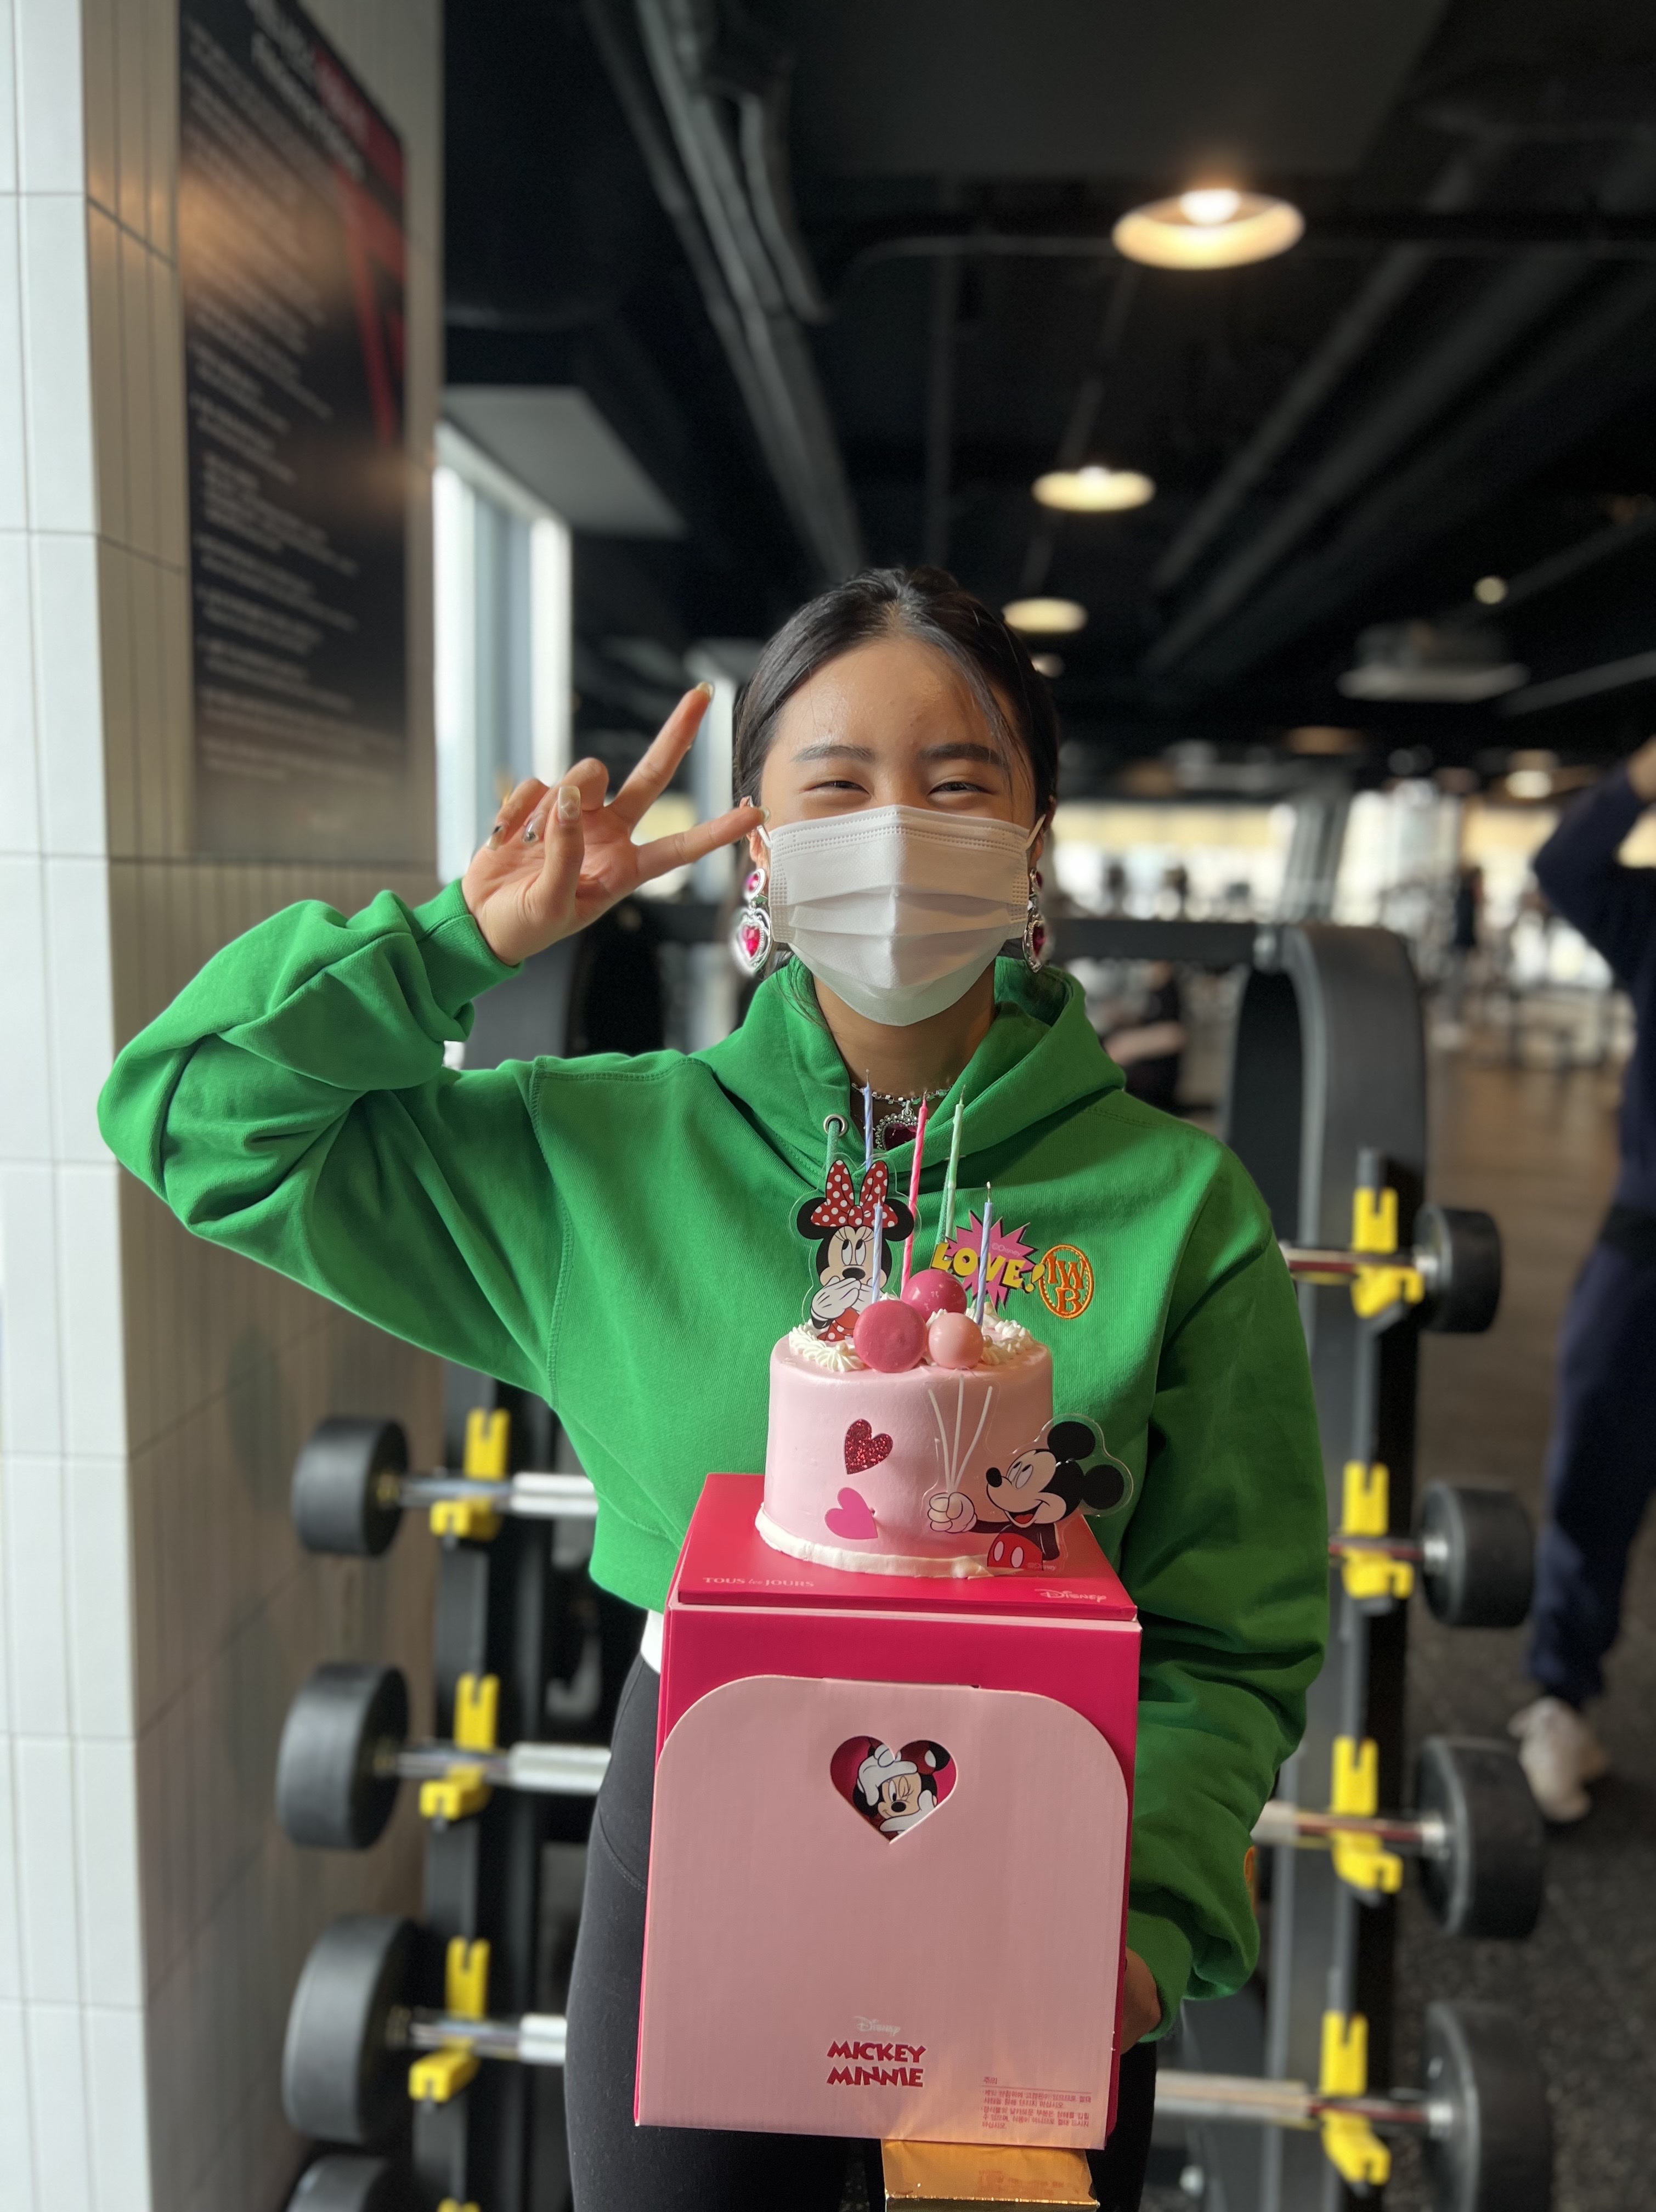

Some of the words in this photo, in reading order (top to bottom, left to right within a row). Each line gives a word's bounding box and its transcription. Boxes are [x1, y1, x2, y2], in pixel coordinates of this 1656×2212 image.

[931, 1243, 1045, 1293] LOVE!
[1034, 1588, 1107, 1603] Disney
[851, 2015, 901, 2037] Disney
[826, 2040, 927, 2063] MICKEY
[826, 2066, 924, 2087] MINNIE
